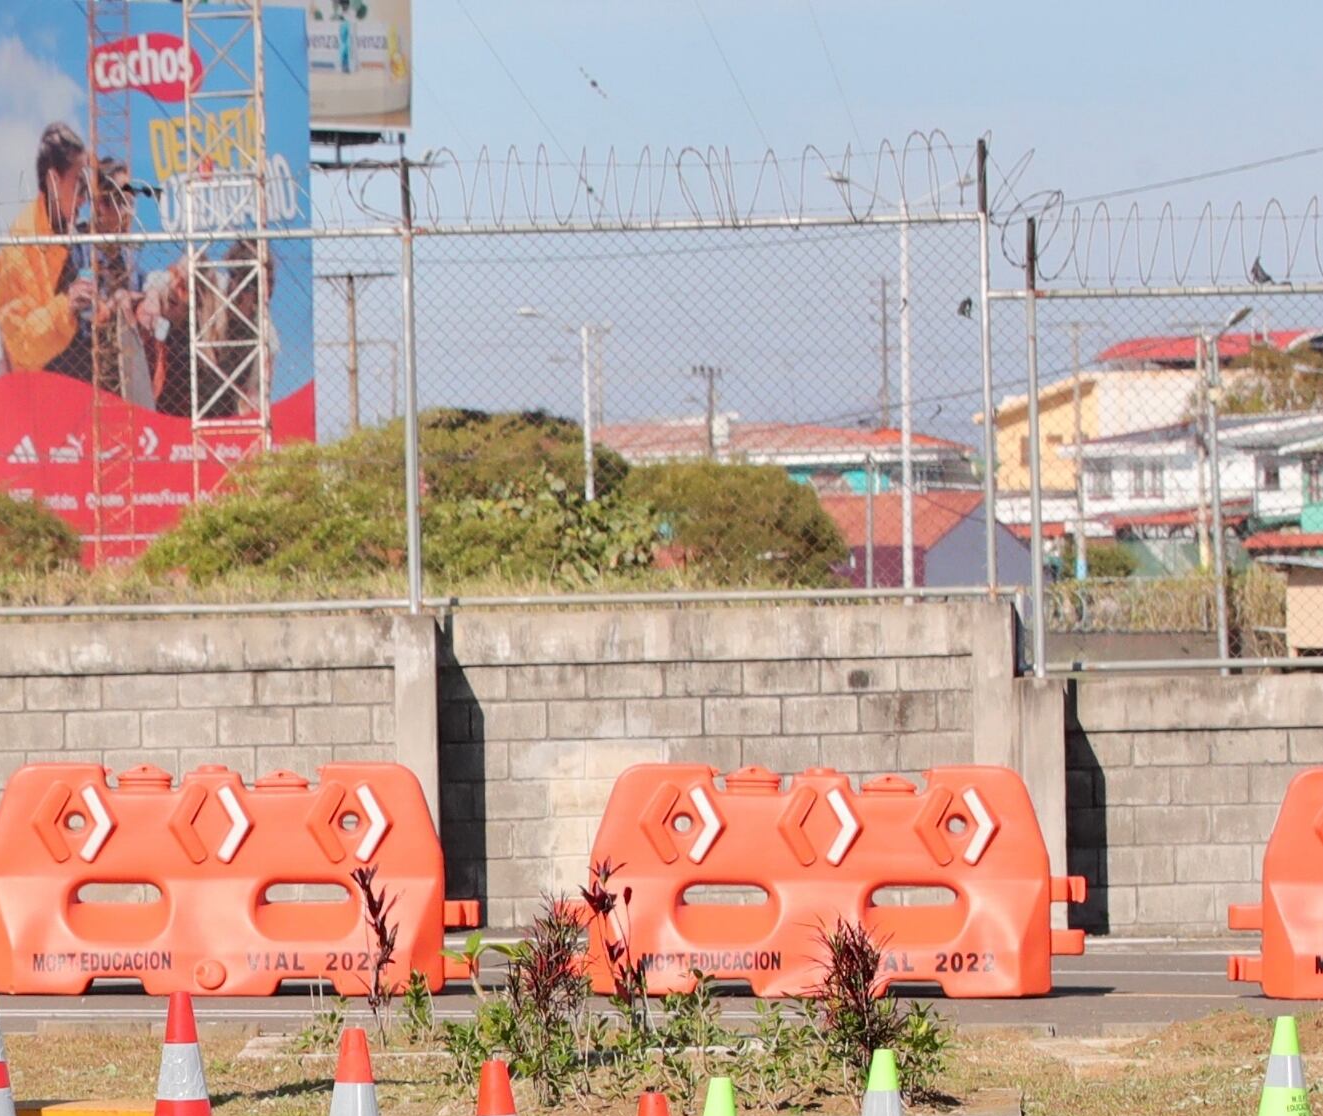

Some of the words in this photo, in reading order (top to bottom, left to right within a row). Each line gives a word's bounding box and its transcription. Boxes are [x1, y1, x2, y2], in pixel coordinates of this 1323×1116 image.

[95, 33, 194, 89] cachos
[247, 952, 305, 971] VIAL
[935, 952, 995, 973] 2022
